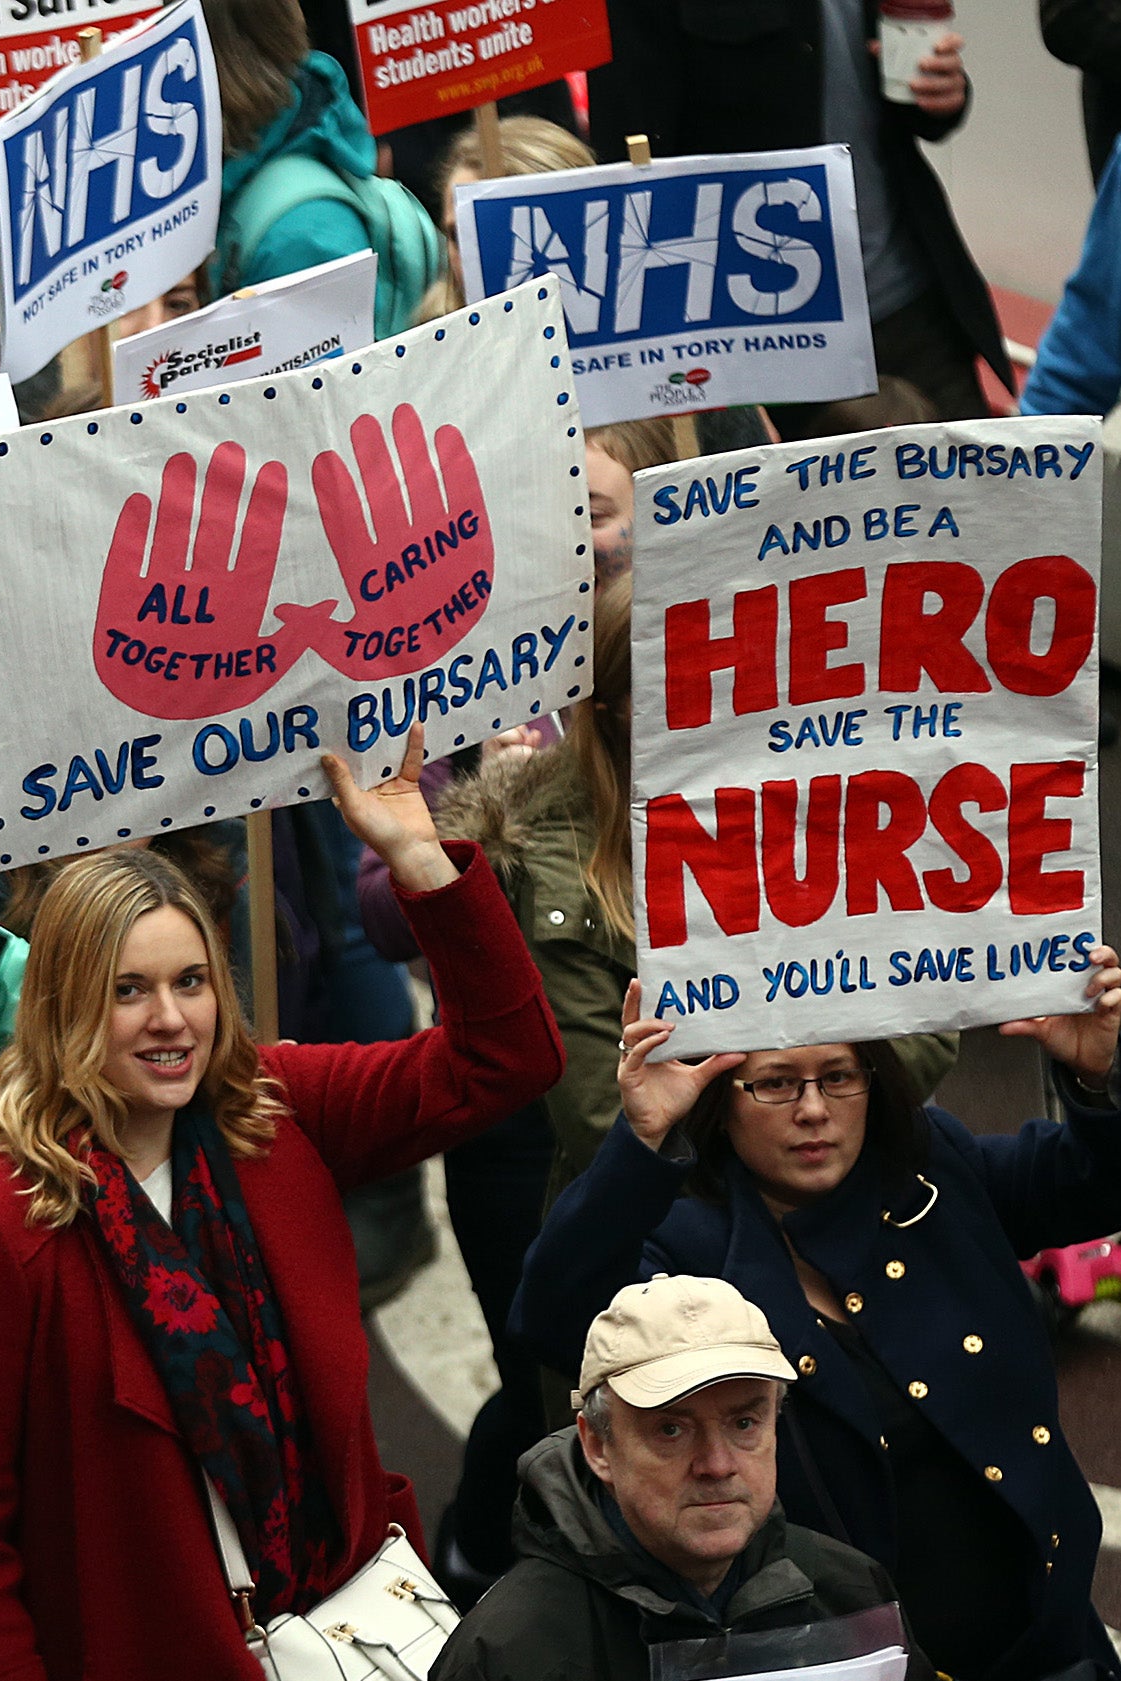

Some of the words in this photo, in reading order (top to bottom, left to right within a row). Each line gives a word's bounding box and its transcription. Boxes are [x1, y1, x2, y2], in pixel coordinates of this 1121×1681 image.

[11, 36, 80, 73] worke
[369, 11, 445, 55] Health
[375, 42, 475, 89] students
[480, 22, 533, 61] unite
[18, 37, 199, 286] NHS
[23, 293, 46, 324] NOT
[48, 267, 79, 301] SAFE
[82, 257, 99, 276] IN
[104, 231, 147, 264] TORY
[152, 200, 200, 242] HANDS
[505, 177, 823, 335] NHS
[160, 355, 226, 388] Party
[167, 332, 262, 370] Socialist
[572, 353, 631, 375] SAFE
[641, 349, 665, 365] IN
[672, 338, 734, 360] TORY
[744, 333, 827, 352] HANDS
[653, 465, 761, 525] SAVE
[786, 444, 878, 491] THE
[895, 441, 1096, 482] BURSARY
[360, 510, 480, 603] CARING
[758, 514, 851, 560] AND
[864, 504, 922, 541] BE
[927, 506, 961, 538] A
[137, 582, 215, 626] ALL
[344, 570, 493, 661] TOGETHER
[106, 629, 277, 682] TOGETHER
[664, 555, 1098, 731] HERO
[20, 734, 165, 820] SAVE
[192, 705, 320, 777] OUR
[346, 615, 576, 753] BURSARY
[767, 709, 867, 753] SAVE
[883, 702, 964, 743] THE
[644, 760, 1088, 949] NURSE
[655, 973, 741, 1020] AND
[762, 951, 877, 1003] YOU'LL
[888, 947, 975, 987] SAVE
[986, 931, 1097, 981] LIVES
